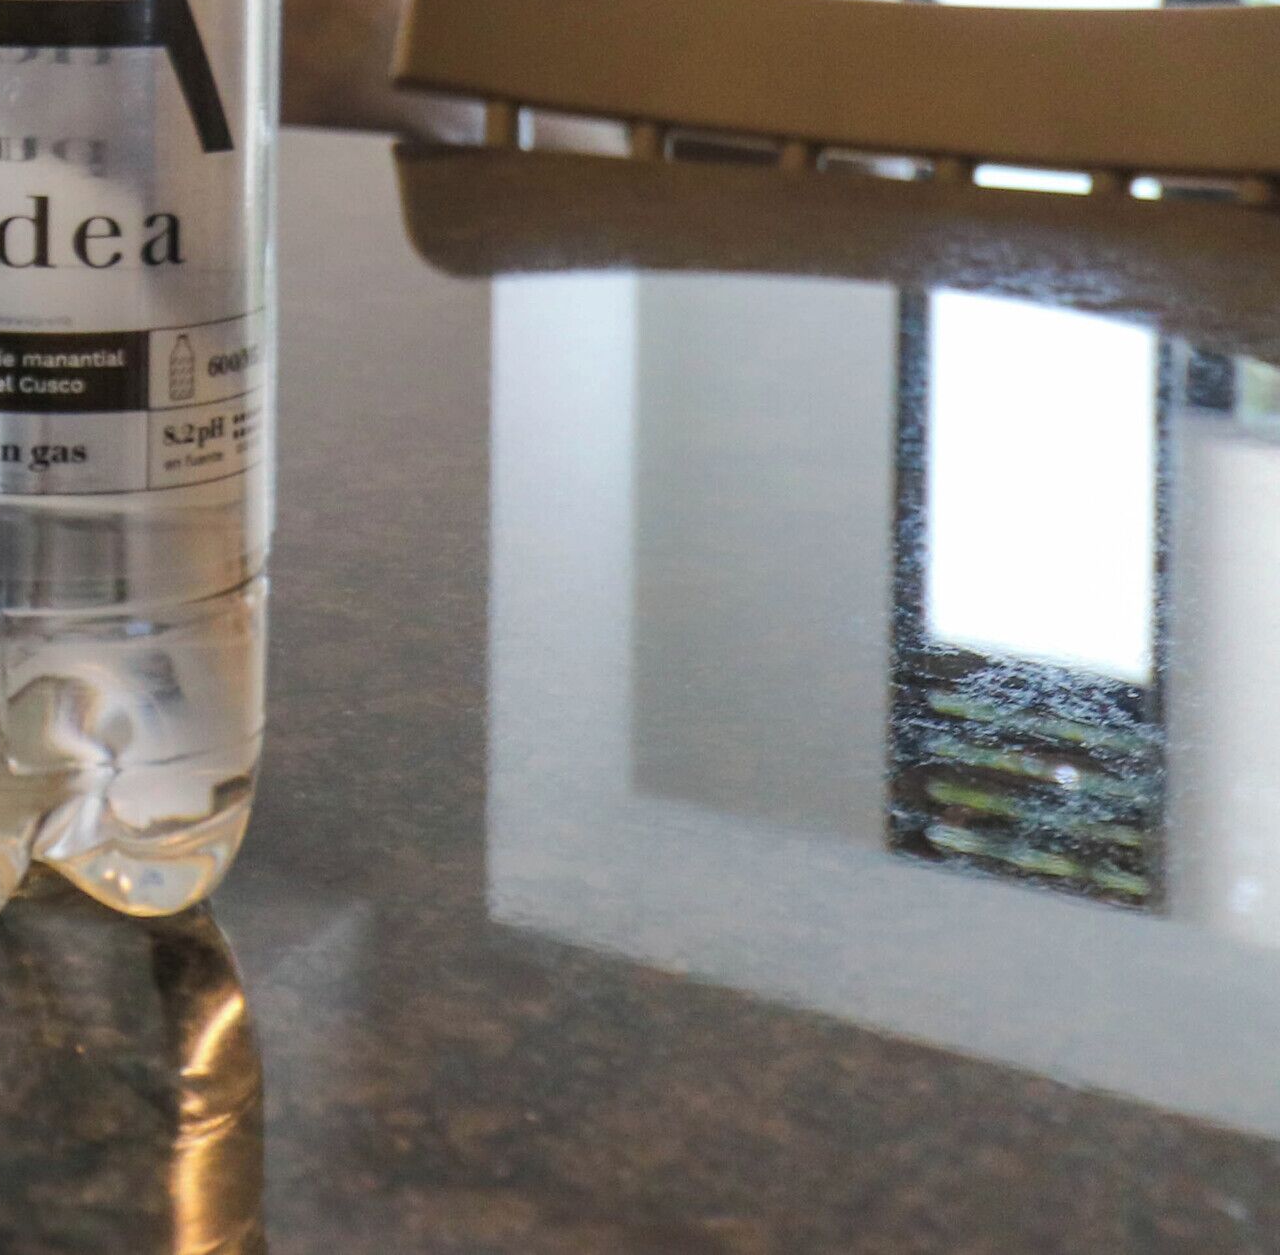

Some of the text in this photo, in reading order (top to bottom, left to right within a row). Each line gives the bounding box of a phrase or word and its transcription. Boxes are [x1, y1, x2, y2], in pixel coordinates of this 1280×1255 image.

[22, 348, 125, 368] manantial
[19, 375, 85, 394] Cusco
[28, 442, 88, 473] gas
